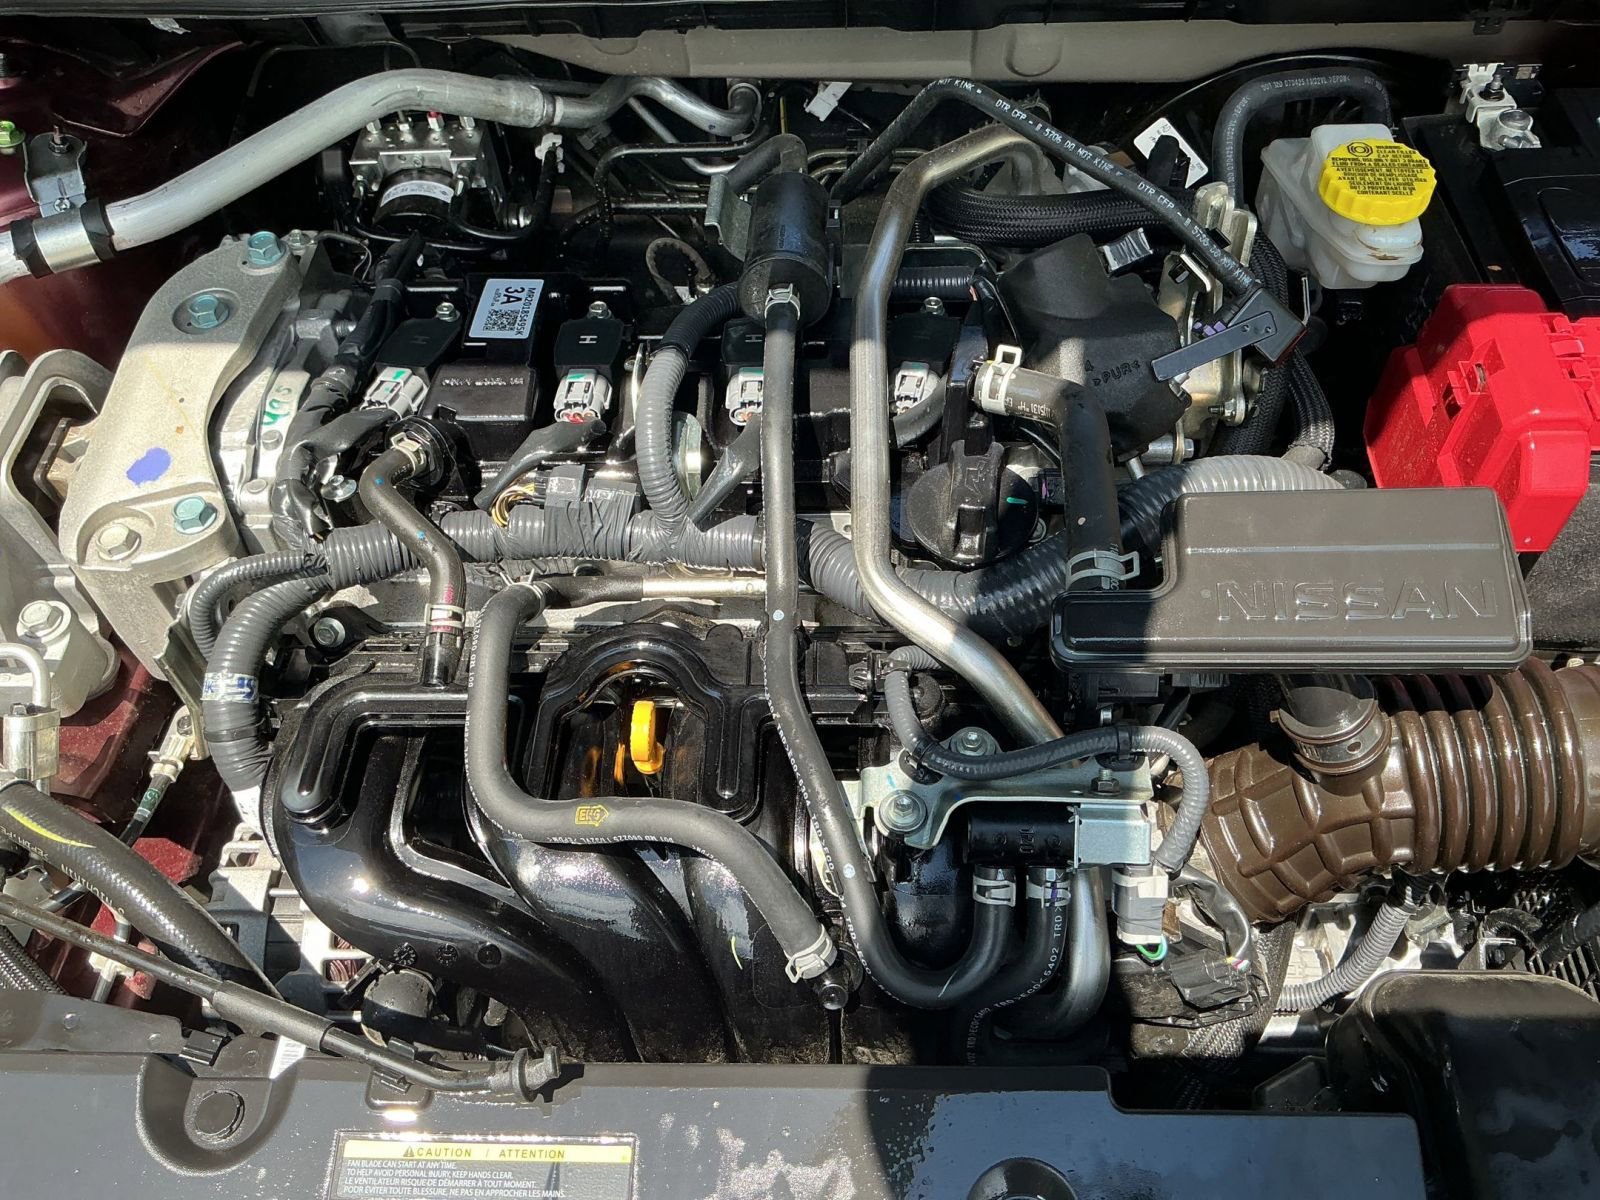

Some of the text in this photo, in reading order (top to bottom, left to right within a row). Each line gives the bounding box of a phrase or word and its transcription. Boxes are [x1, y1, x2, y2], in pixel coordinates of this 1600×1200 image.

[995, 98, 1011, 113] DTR
[1137, 182, 1156, 197] DTR
[500, 286, 525, 305] 3A
[1216, 579, 1498, 620] NISSAN
[417, 1147, 472, 1158] CAUTION
[499, 1149, 566, 1159] ATTENTION
[347, 1160, 361, 1168] FAN
[361, 1160, 383, 1168] BLADE
[383, 1160, 397, 1168] CAN
[397, 1160, 417, 1169] START
[417, 1161, 426, 1169] AT
[426, 1161, 440, 1169] ANY
[347, 1168, 356, 1176] TO
[357, 1168, 373, 1176] HELP
[374, 1168, 394, 1176] AVOID
[394, 1169, 427, 1178] PERSONAL
[452, 1171, 468, 1179] KEEP
[468, 1171, 491, 1179] HANDS
[493, 1171, 514, 1180] CLEAR.
[344, 1177, 353, 1185] LE
[354, 1178, 400, 1186] VENTILATEUR
[400, 1179, 425, 1187] RISQUE
[427, 1179, 438, 1187] DE
[484, 1180, 503, 1188] TOUT
[503, 1180, 537, 1189] MOMENT.
[389, 1187, 412, 1196] TOUTE
[449, 1188, 459, 1196] NE
[460, 1188, 474, 1197] PAS
[474, 1189, 485, 1197] EN
[485, 1189, 528, 1198] APPROCHER
[528, 1190, 541, 1198] LES
[541, 1190, 567, 1199] MAINS.
